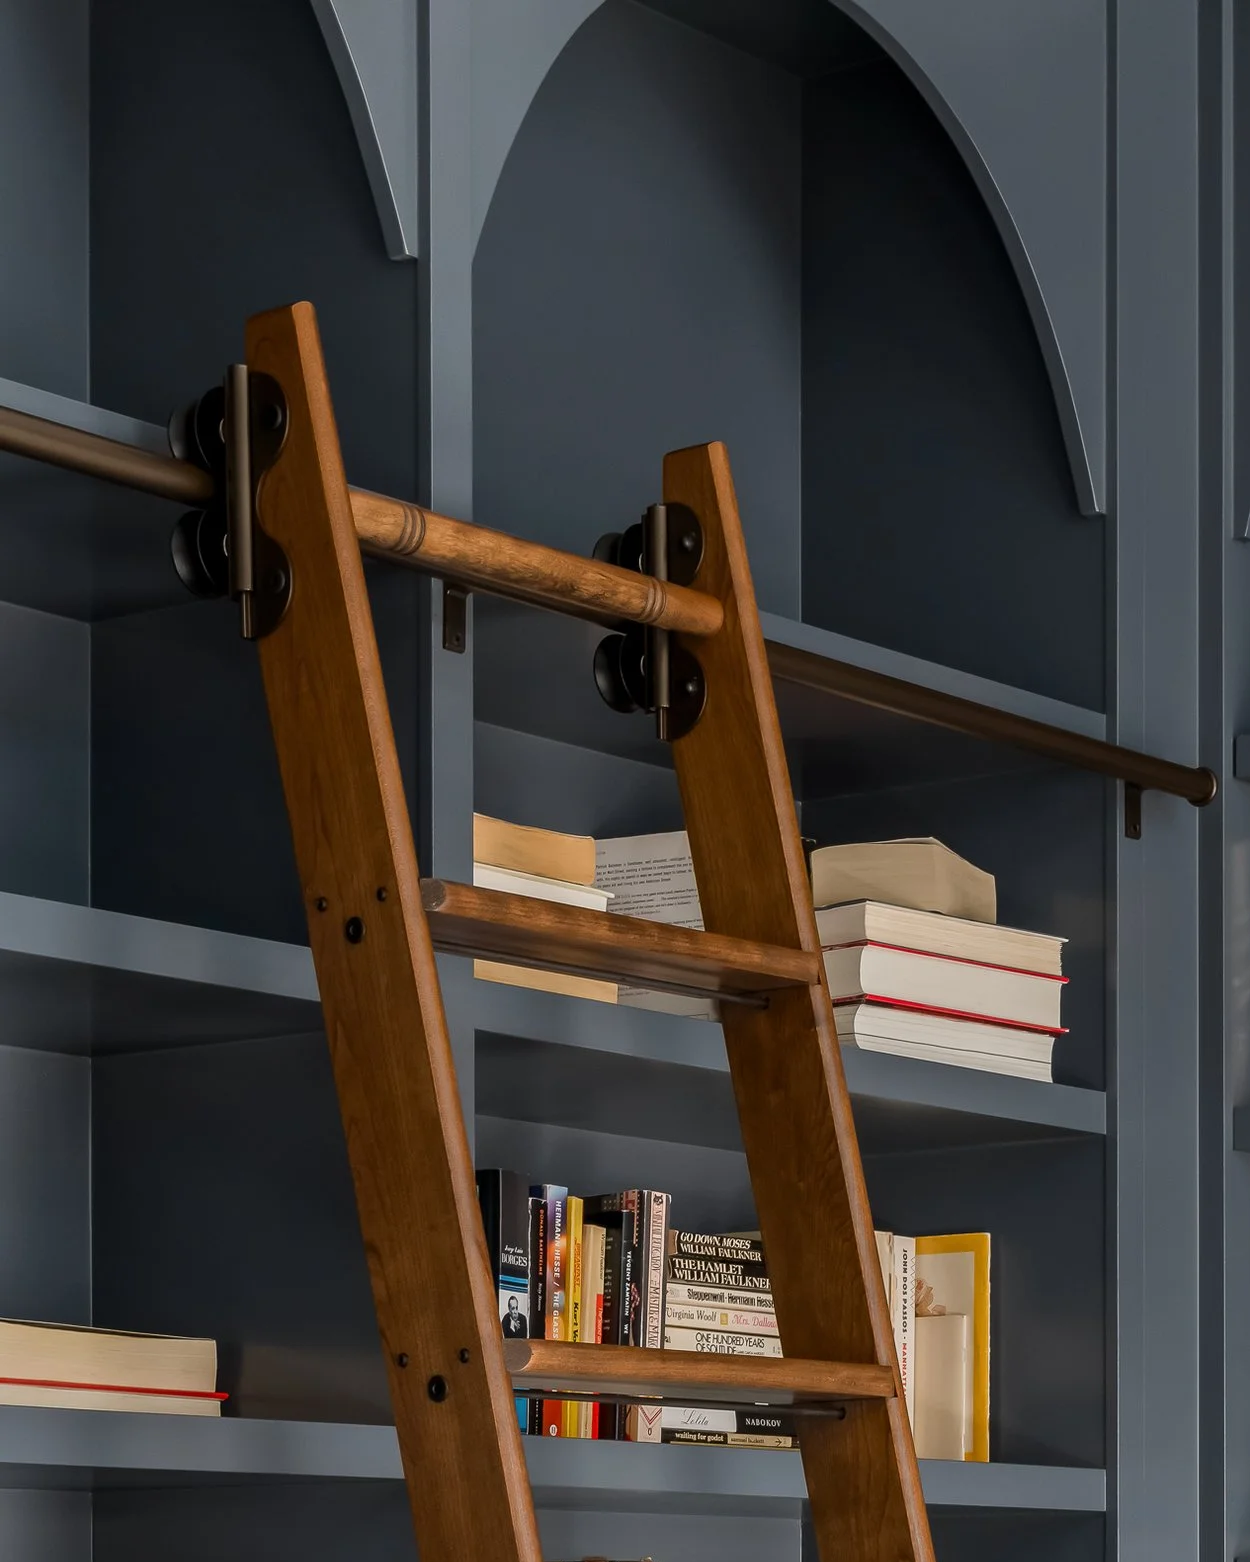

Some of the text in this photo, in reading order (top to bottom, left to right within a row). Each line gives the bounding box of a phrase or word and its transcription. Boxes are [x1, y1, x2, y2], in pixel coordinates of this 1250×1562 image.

[554, 1200, 562, 1249] HERMANN
[680, 1232, 694, 1242] GO
[721, 1237, 751, 1249] MOSES
[501, 1252, 527, 1267] BORGES
[680, 1243, 762, 1261] WILLIAM FAULKNER
[553, 1249, 561, 1278] HESSE
[673, 1258, 744, 1275] THE HAMLET
[674, 1268, 720, 1284] WILLIAM
[727, 1293, 755, 1306] Hermann
[552, 1311, 560, 1339] GLASS
[666, 1307, 694, 1321] Virginia
[697, 1309, 717, 1321] Woolf
[753, 1316, 777, 1328] Dallow
[623, 1323, 629, 1334] WE
[695, 1332, 765, 1349] ONE HUNDRED YEARS
[695, 1343, 706, 1352] OF
[745, 1417, 782, 1428] NABOKOV
[674, 1432, 724, 1443] waiting for godot
